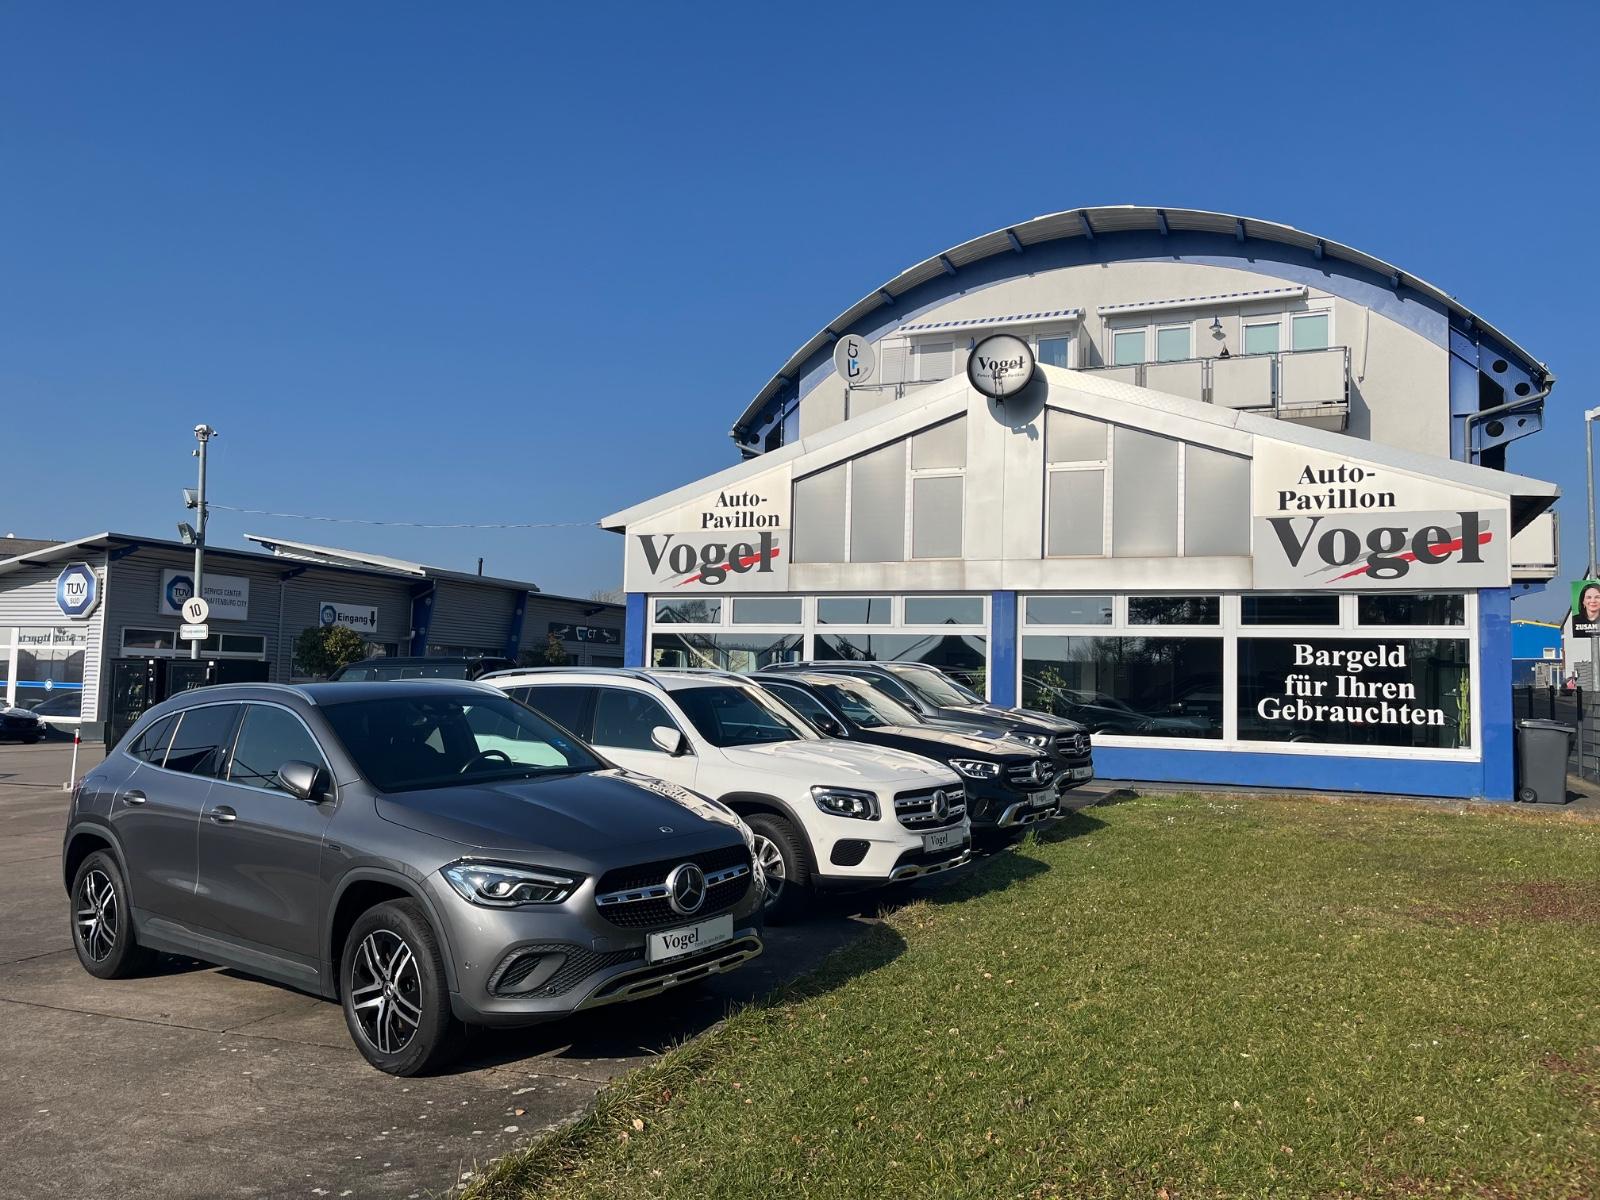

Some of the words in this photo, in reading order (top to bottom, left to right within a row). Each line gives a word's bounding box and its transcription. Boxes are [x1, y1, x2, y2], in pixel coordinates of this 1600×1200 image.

[978, 355, 1025, 373] Vogel
[1297, 463, 1376, 485] Auto-
[715, 491, 768, 508] Auto-
[1277, 488, 1396, 511] Pavillon
[701, 511, 780, 529] Pavillon
[1265, 511, 1485, 580] Vogel
[636, 531, 775, 585] Vogel
[66, 582, 86, 595] TÜV
[189, 603, 202, 618] 10
[337, 612, 368, 626] Eingang
[1293, 643, 1407, 673] Bargeld
[1284, 674, 1328, 697] für
[1335, 675, 1416, 700] Ihren
[1257, 697, 1446, 726] Gebrauchten
[930, 832, 948, 847] Vogel
[662, 927, 699, 950] Vogel
